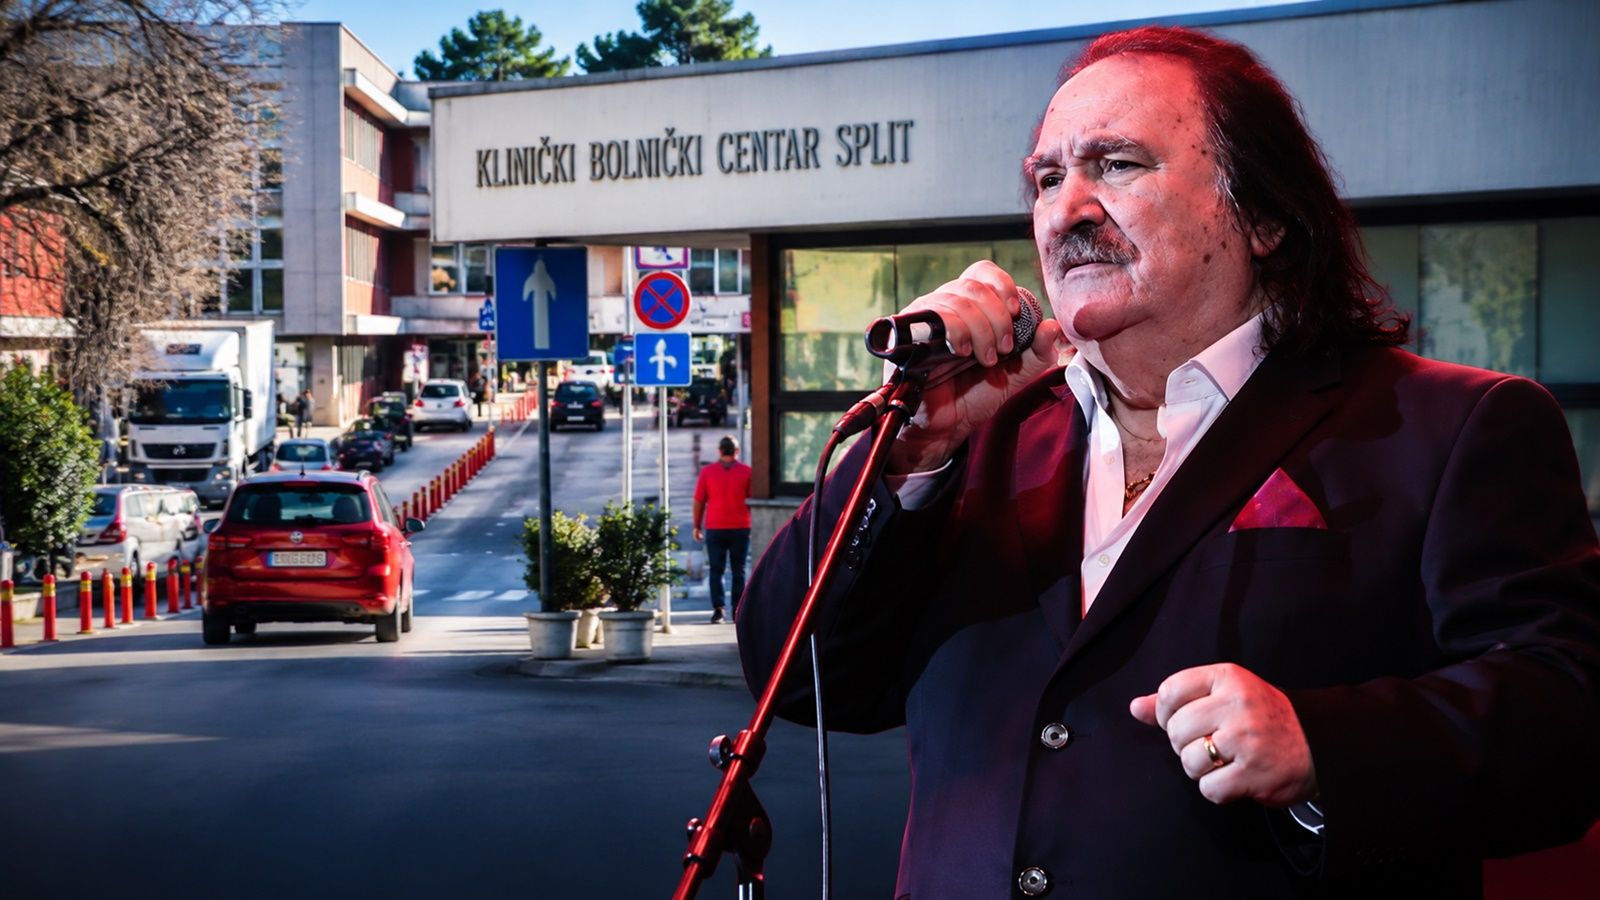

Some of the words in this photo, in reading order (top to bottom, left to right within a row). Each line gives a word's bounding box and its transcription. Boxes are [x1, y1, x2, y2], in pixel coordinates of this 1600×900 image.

[476, 136, 576, 188] KLINIČKI
[589, 127, 703, 182] BOLNIČKI
[716, 127, 821, 175] CENTAR
[836, 120, 914, 168] SPLIT
